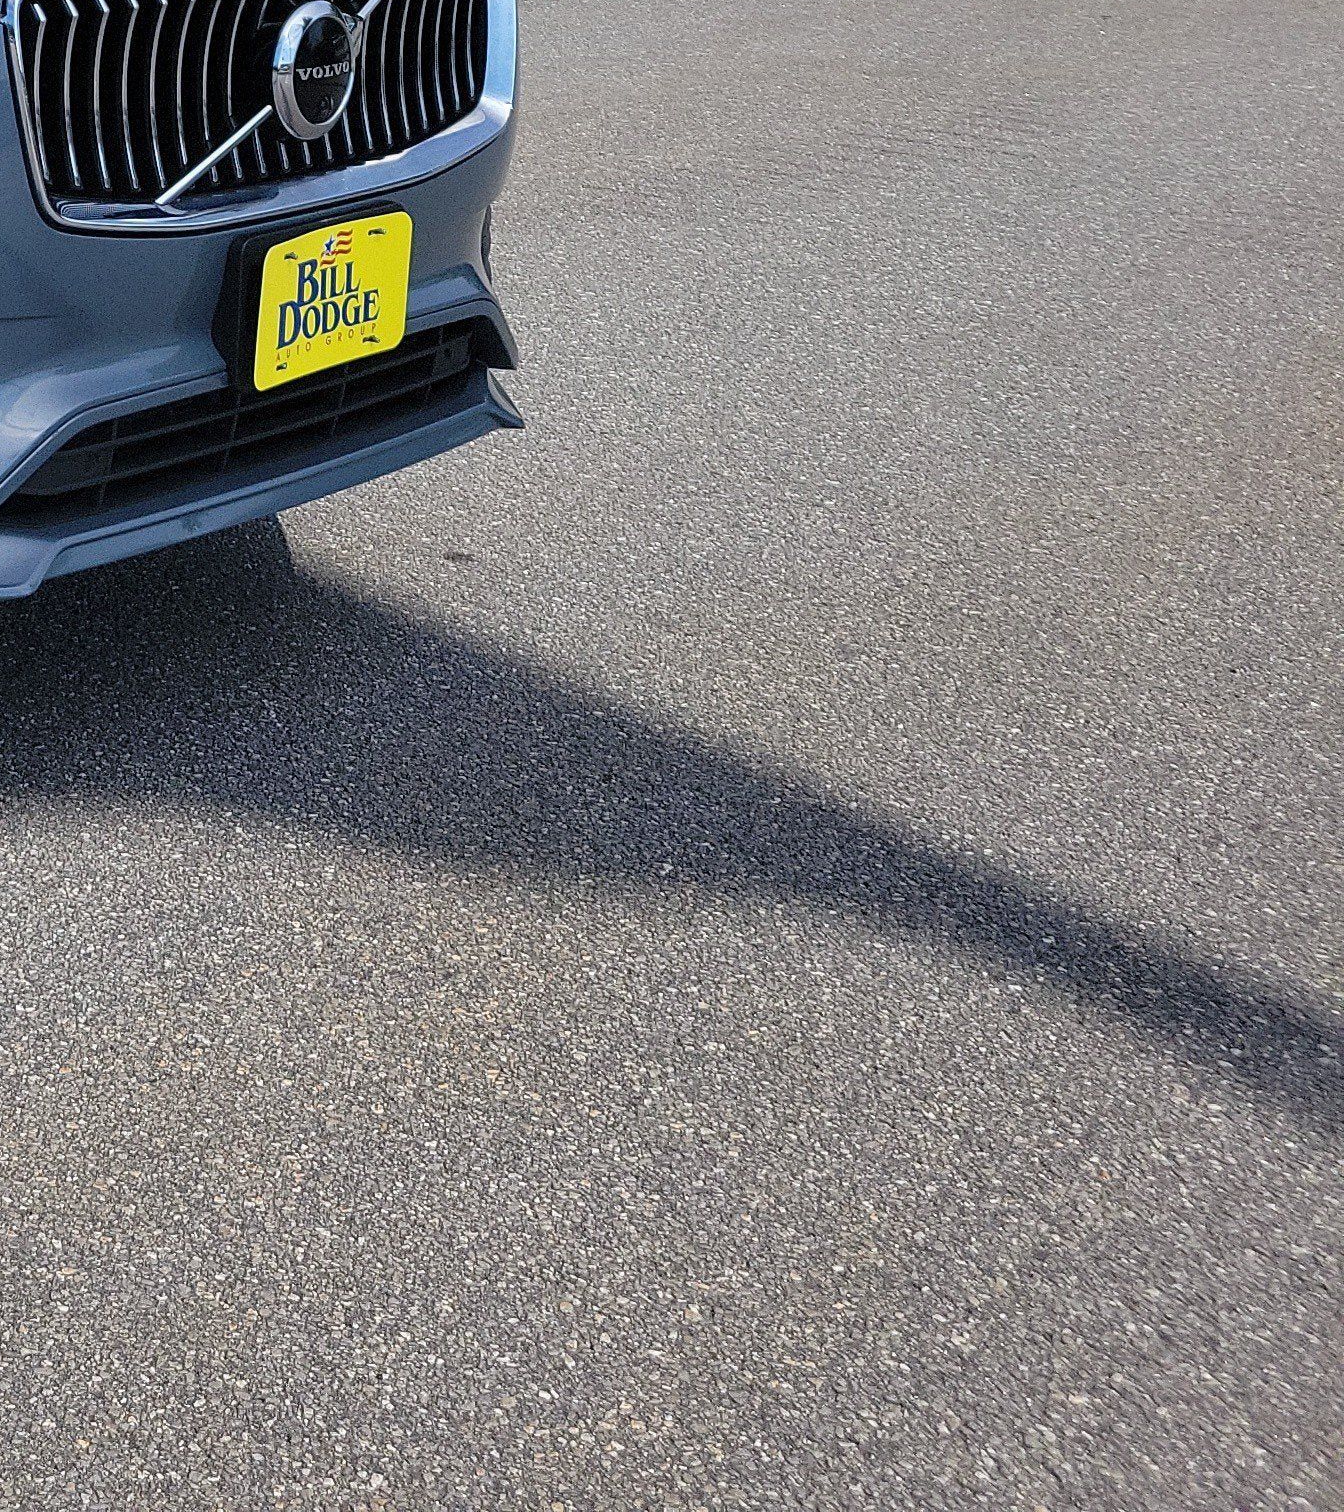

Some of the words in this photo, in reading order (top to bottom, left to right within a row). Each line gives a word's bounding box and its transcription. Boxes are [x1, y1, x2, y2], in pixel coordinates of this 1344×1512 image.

[296, 61, 350, 81] VOLVO
[297, 259, 361, 308] BILL
[275, 289, 382, 350] DODGE
[325, 323, 377, 346] GROUP
